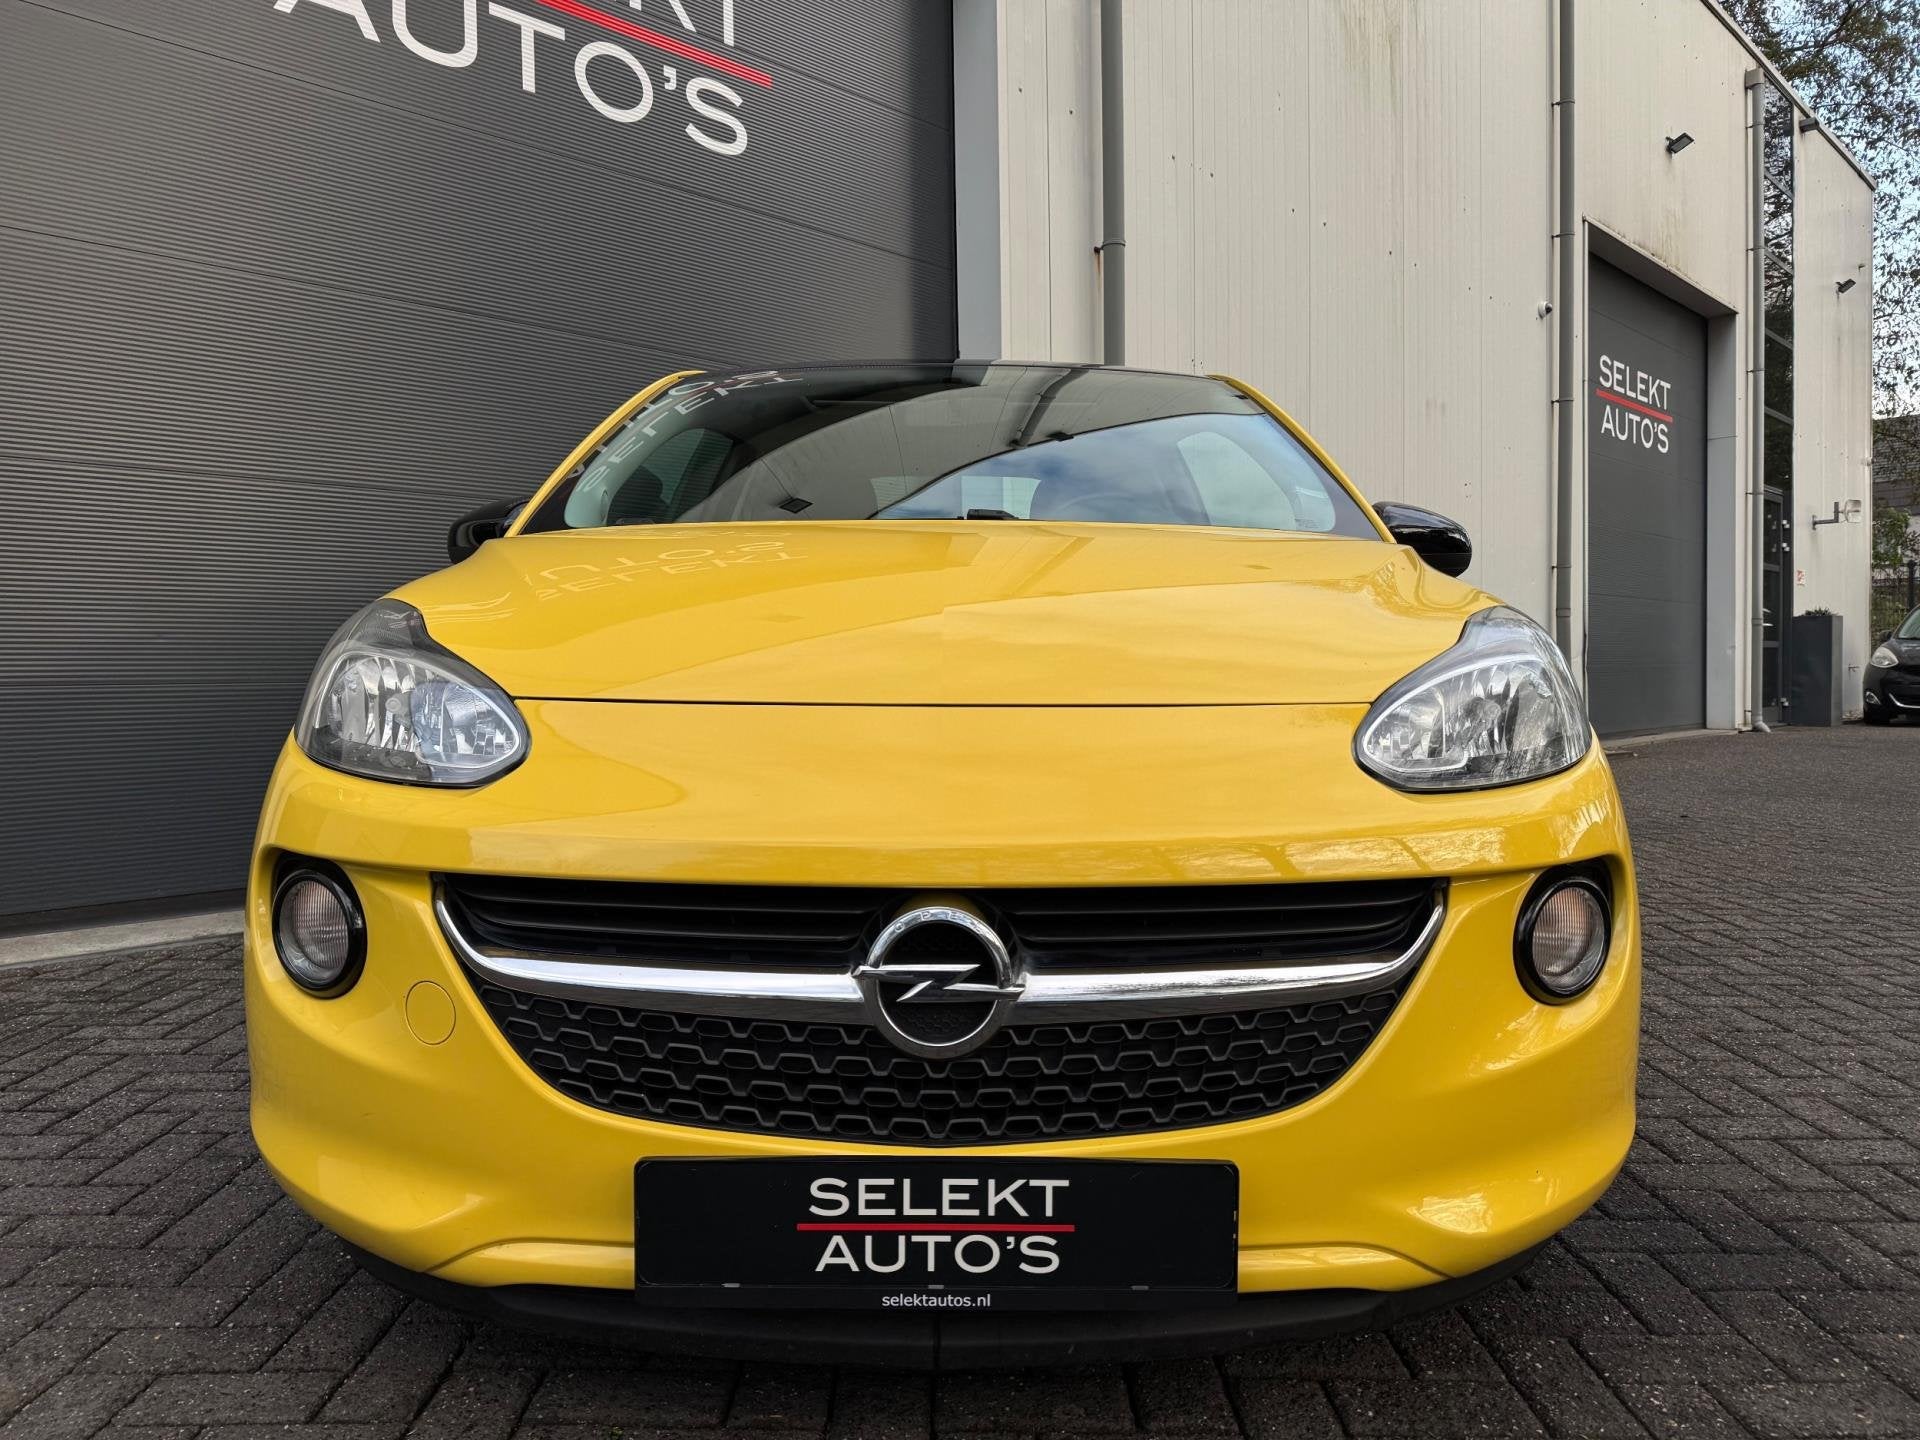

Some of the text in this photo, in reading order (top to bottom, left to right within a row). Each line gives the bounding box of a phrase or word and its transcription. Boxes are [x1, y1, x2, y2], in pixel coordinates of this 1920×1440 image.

[1599, 354, 1671, 410] SELEKT
[1601, 404, 1669, 453] AUTO'S
[808, 1177, 1070, 1217] SELEKT
[814, 1234, 1061, 1274] AUTO'S
[881, 1293, 991, 1307] selektautos.nl
